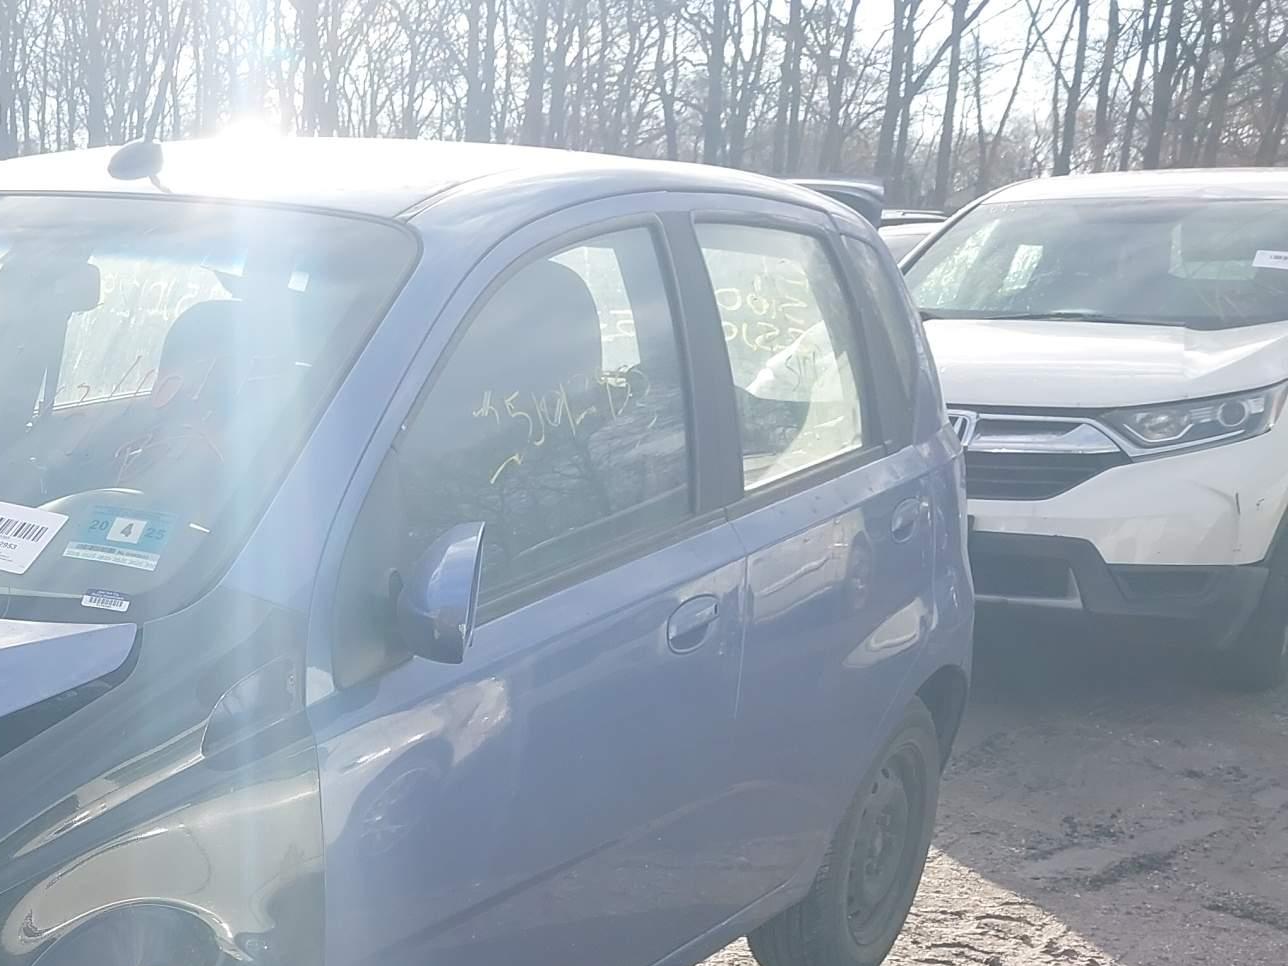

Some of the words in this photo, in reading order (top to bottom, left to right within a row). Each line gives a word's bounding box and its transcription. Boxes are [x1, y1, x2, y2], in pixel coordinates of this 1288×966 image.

[88, 518, 109, 532] 20
[119, 522, 134, 538] 4
[143, 526, 167, 541] 25
